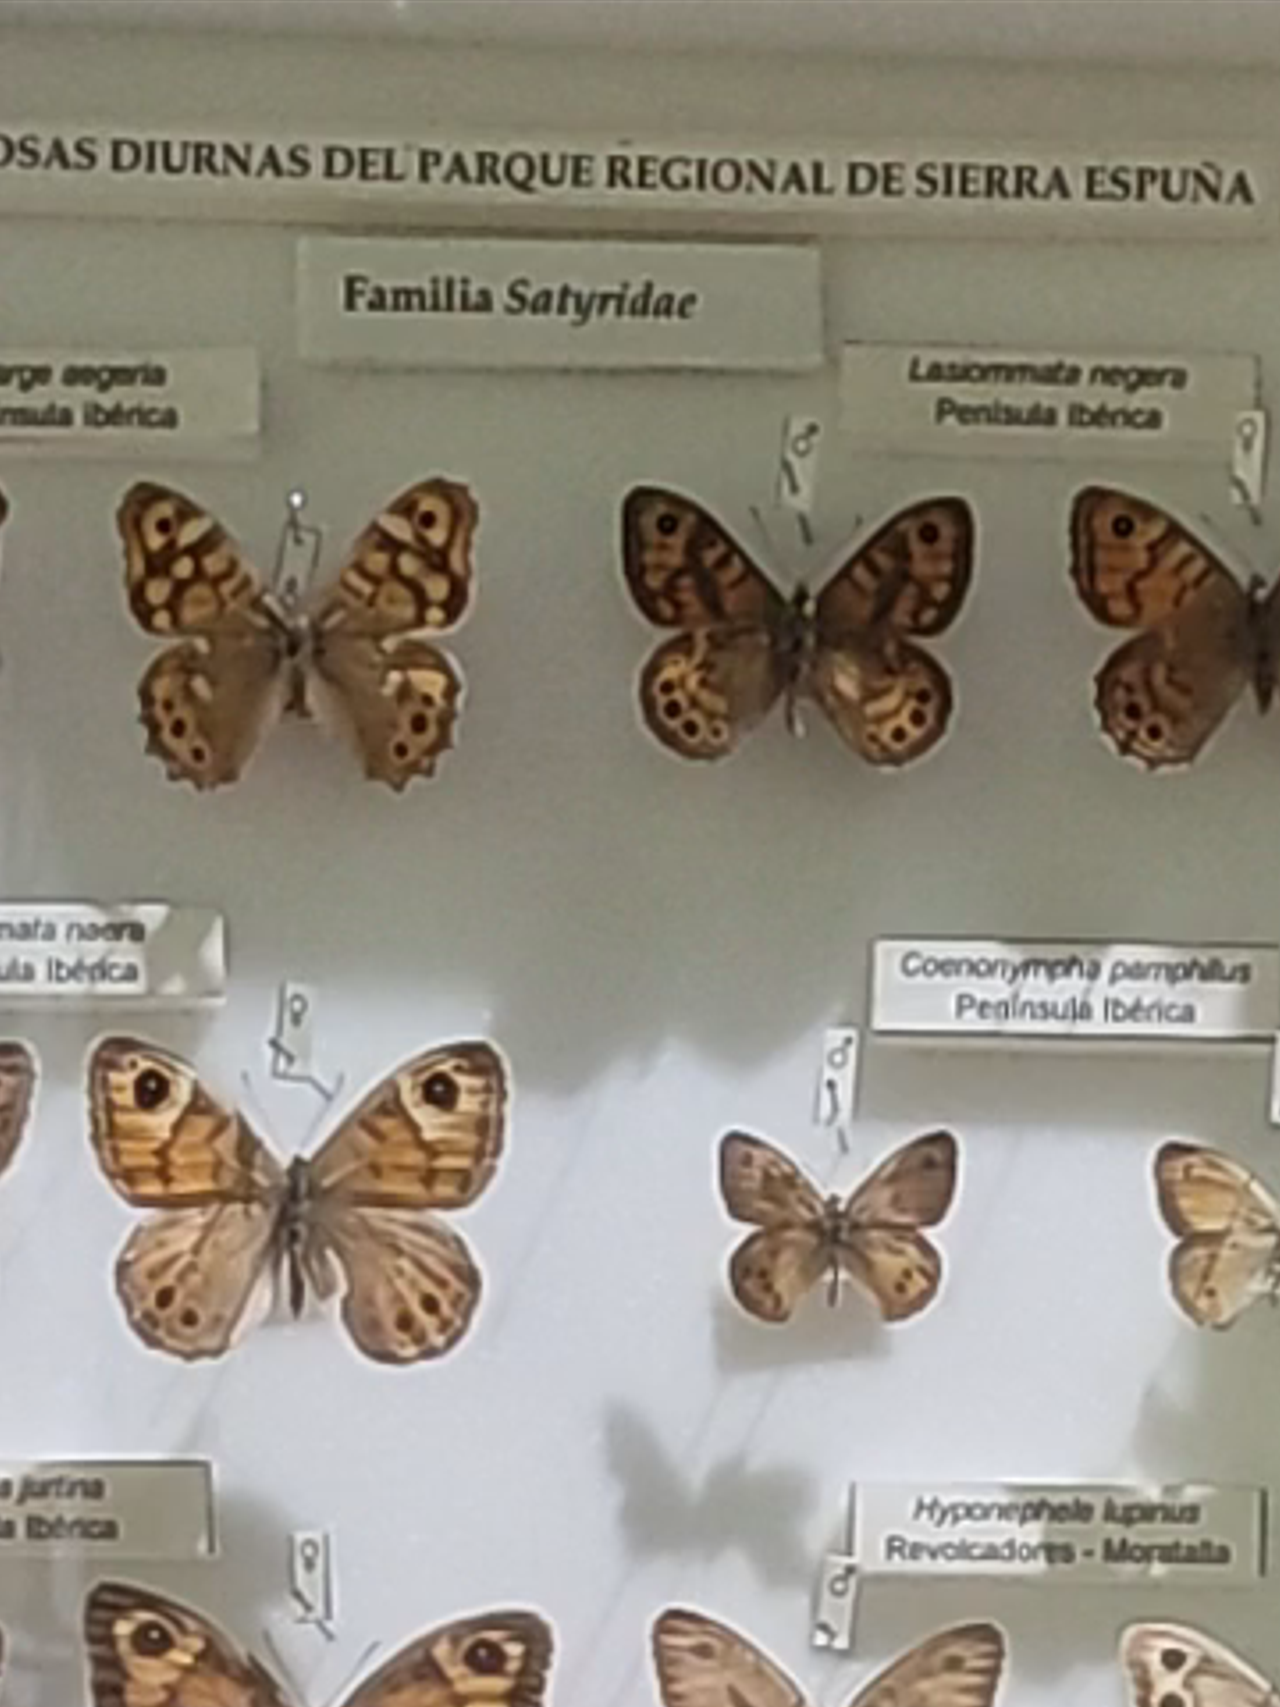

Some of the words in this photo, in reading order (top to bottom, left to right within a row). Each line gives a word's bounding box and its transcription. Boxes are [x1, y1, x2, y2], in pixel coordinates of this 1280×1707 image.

[111, 138, 311, 178] DIURNAS
[323, 145, 406, 183] DEL
[418, 148, 594, 194] PARQUE
[605, 155, 835, 196] REGIONAL
[847, 162, 904, 197] DE
[915, 163, 1071, 200] SIERRA
[1085, 161, 1256, 206] ESPUÑA
[343, 276, 492, 313] Familia
[504, 279, 697, 326] Satyridae
[1103, 996, 1195, 1024] Ibérica
